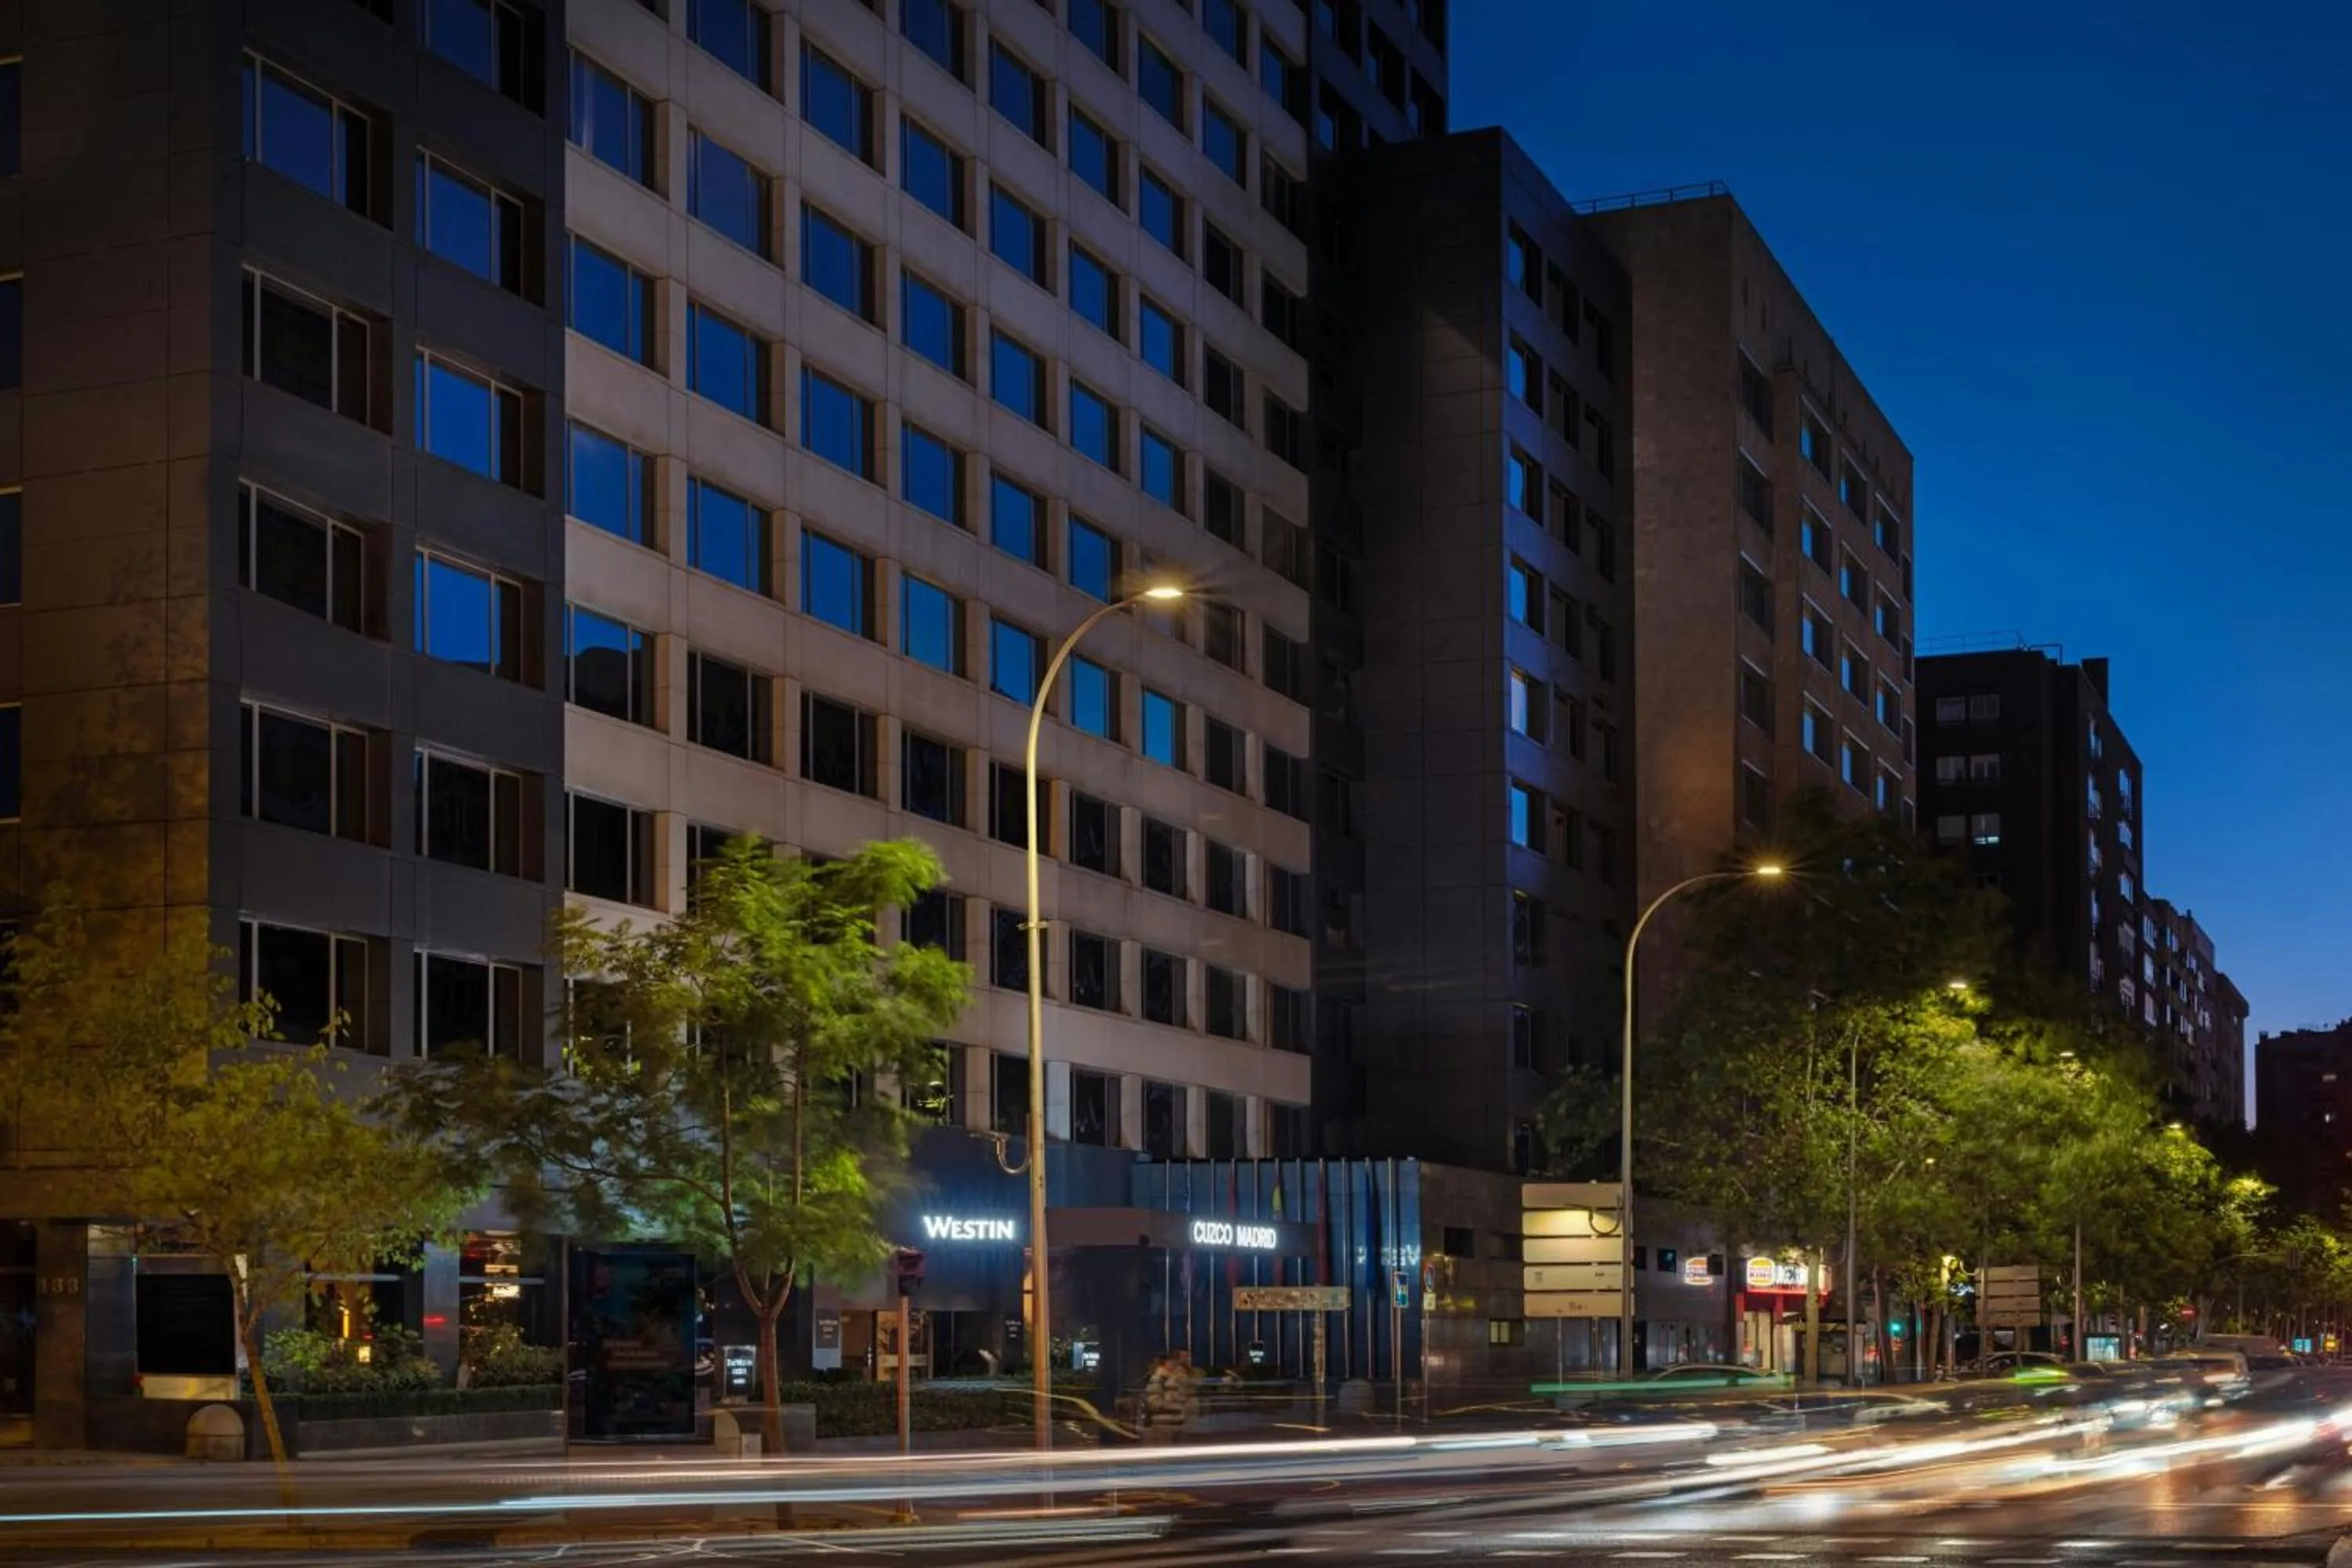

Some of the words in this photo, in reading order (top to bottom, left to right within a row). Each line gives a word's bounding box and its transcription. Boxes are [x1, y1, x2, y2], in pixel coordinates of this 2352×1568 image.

[922, 1215, 1015, 1240] WESTIN
[1192, 1221, 1233, 1245] CUZCO
[1236, 1225, 1276, 1249] MADRID
